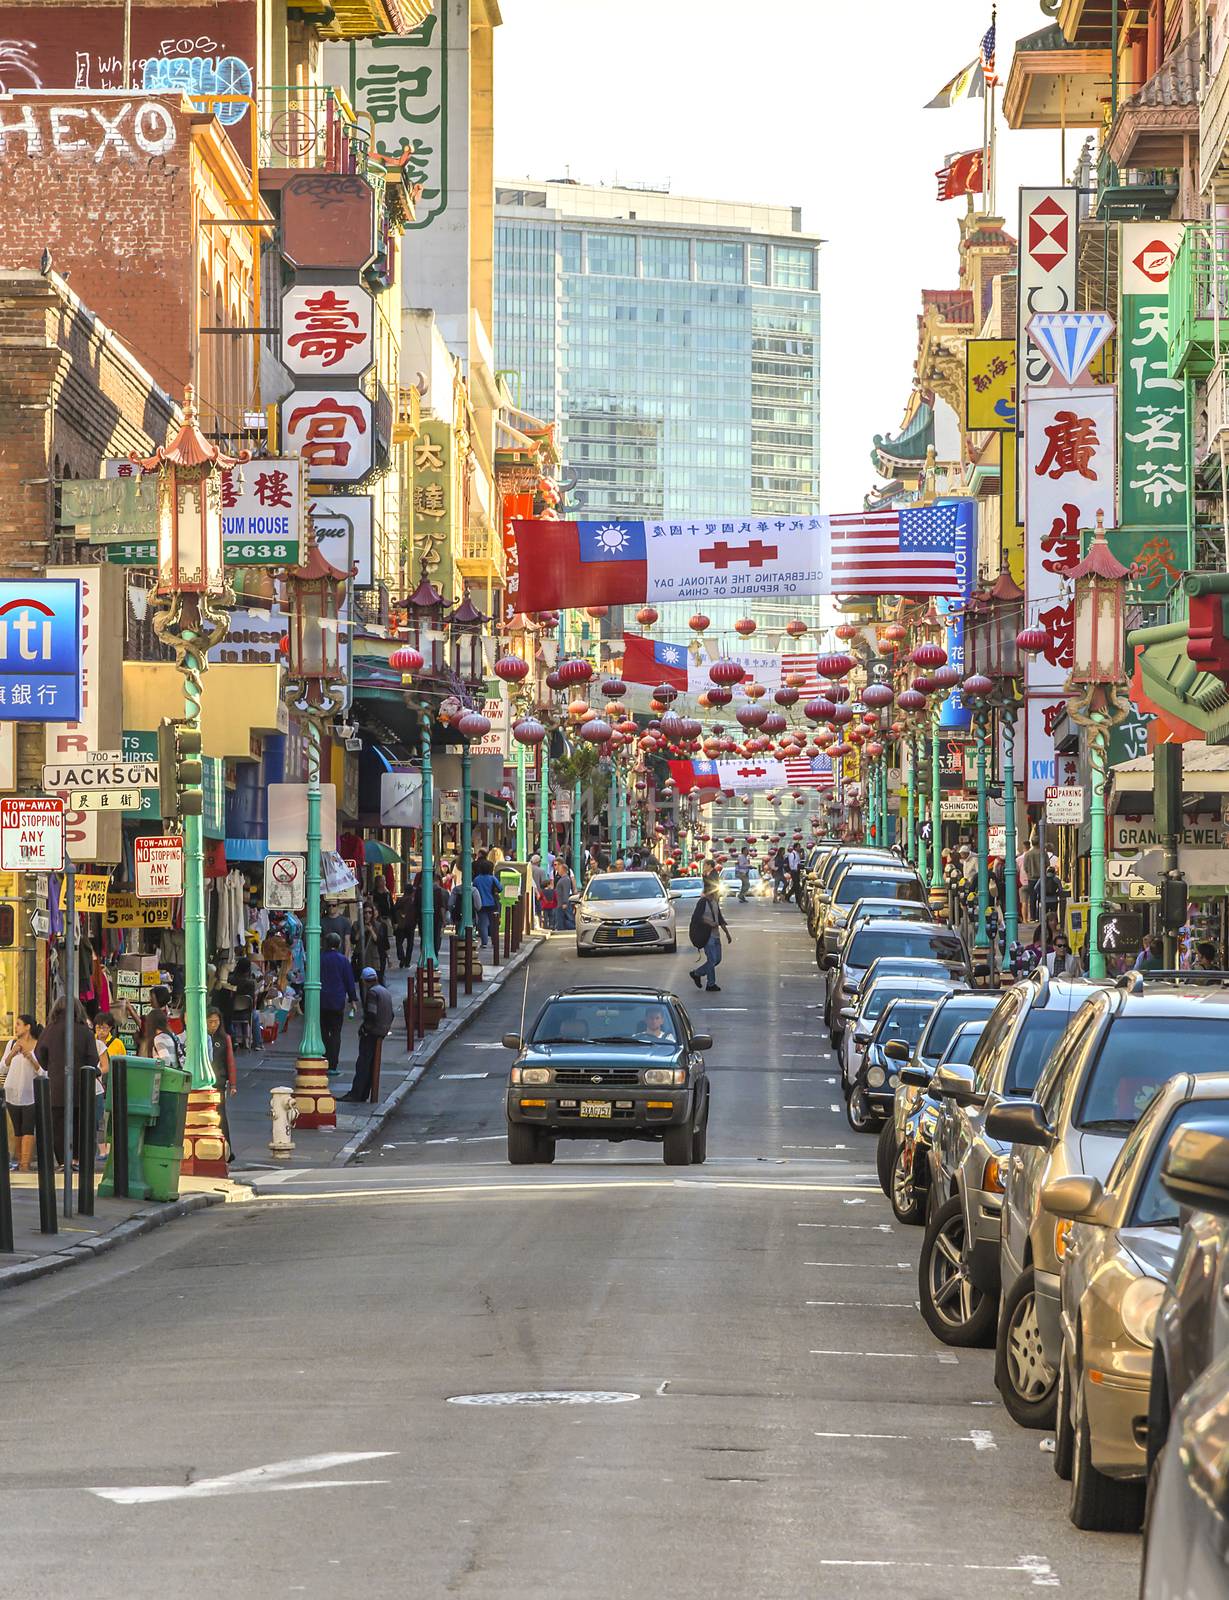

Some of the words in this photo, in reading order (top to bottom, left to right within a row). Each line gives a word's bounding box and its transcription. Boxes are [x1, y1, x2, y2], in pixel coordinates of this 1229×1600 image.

[98, 56, 147, 73] Whre
[249, 517, 289, 534] HOUSE
[122, 736, 140, 749] TS
[91, 753, 108, 761] 700
[48, 767, 158, 786] JACKSON
[6, 801, 58, 810] TOW-AWAY
[2, 811, 19, 827] NO
[22, 814, 60, 827] STOPPING
[21, 831, 43, 842] ANY
[140, 839, 178, 847] TOW-AWAY
[19, 845, 45, 857] TIME
[137, 848, 149, 861] NO
[151, 850, 180, 860] STOPPING
[151, 864, 168, 873] ANY
[150, 876, 170, 885] TIME
[107, 911, 119, 924] 5
[121, 913, 134, 921] FOR
